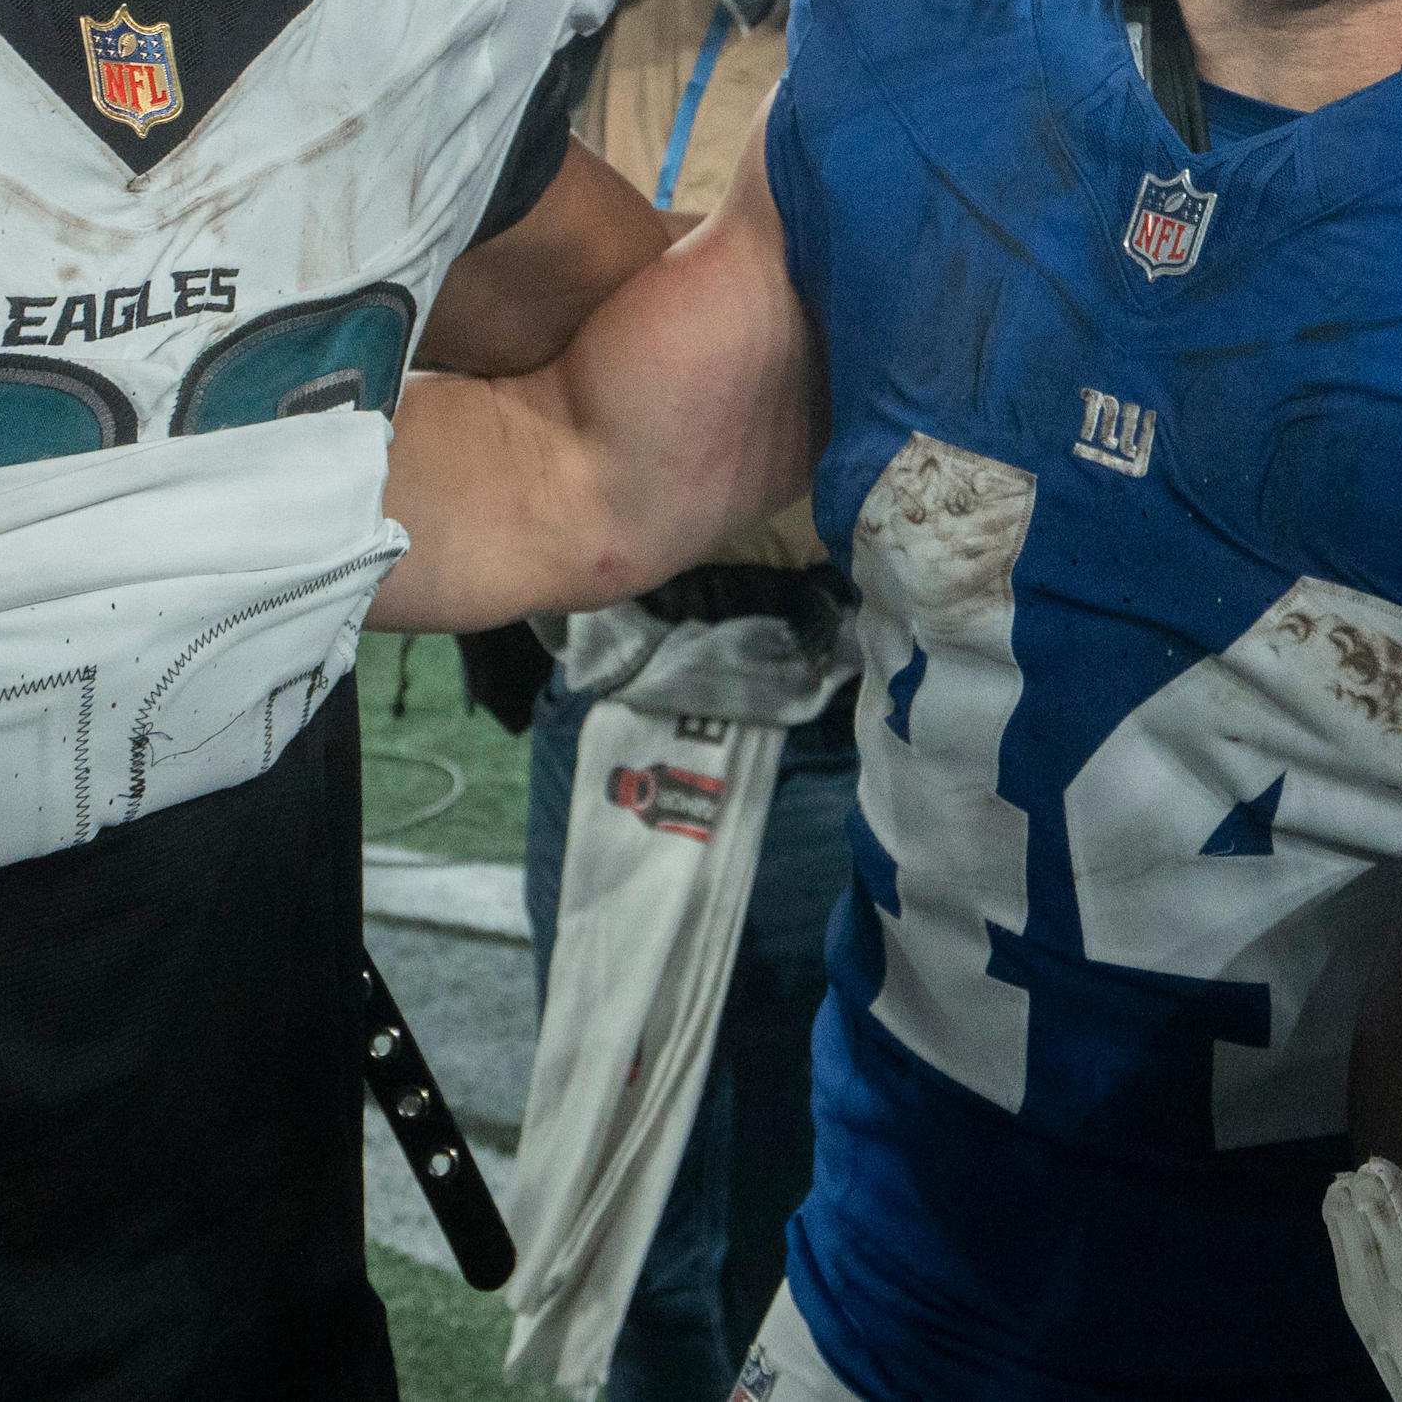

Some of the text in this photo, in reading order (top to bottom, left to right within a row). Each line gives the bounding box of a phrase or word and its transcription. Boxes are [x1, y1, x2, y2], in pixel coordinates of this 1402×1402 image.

[102, 62, 169, 112] NFL
[1134, 212, 1186, 262] NFL
[0, 267, 240, 348] EAGLES
